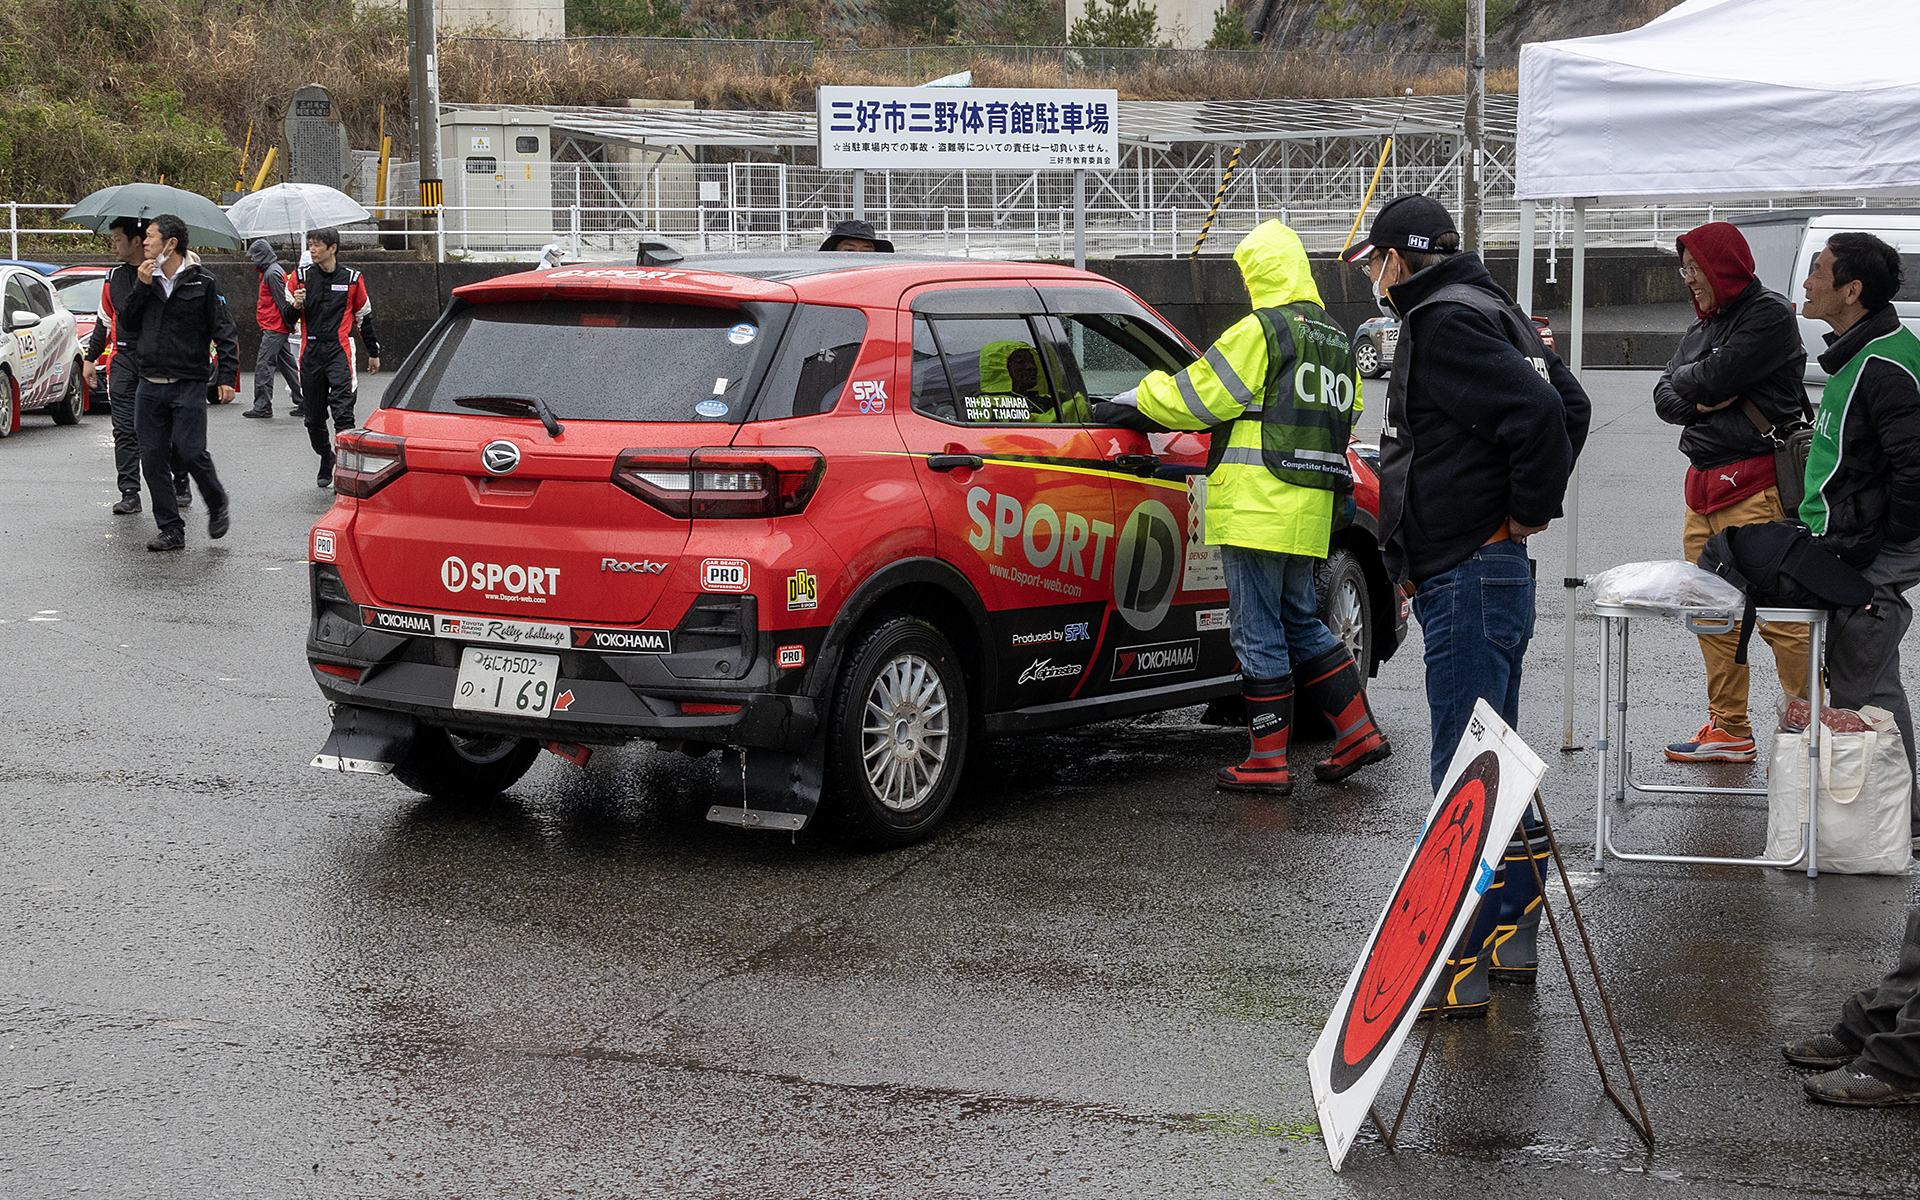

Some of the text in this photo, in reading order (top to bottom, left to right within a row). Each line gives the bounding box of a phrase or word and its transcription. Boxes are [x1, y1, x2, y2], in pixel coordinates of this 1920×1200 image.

[830, 100, 1109, 134] 三好市三野体育館駐車場
[1049, 156, 1111, 164] 三好市教育委員会
[20, 335, 33, 353] 142
[1386, 330, 1399, 341] 122
[853, 380, 888, 400] SPK
[1295, 362, 1353, 413] CRO
[964, 397, 1028, 408] RH+AB T.AIHARA
[966, 409, 1030, 419] RH+O T.HAGINO
[1281, 459, 1321, 470] Competitor
[966, 486, 1115, 581] SPORT
[318, 538, 331, 552] PRO
[1189, 551, 1208, 560] DENSO
[601, 558, 669, 575] Rocky
[711, 568, 739, 582] PRO
[471, 562, 561, 595] SPORT
[789, 571, 816, 601] DRS
[989, 563, 1082, 597] www.Dsport-web.com
[485, 593, 546, 604] www.Dsport-web.com
[376, 612, 431, 631] YOKOHAMA
[441, 621, 565, 645] GR Rally challenge
[594, 633, 664, 649] YOKOHAMA
[1012, 622, 1090, 644] Produced by SPK
[782, 651, 799, 662] PRO
[1137, 647, 1194, 670] YOKOHAMA
